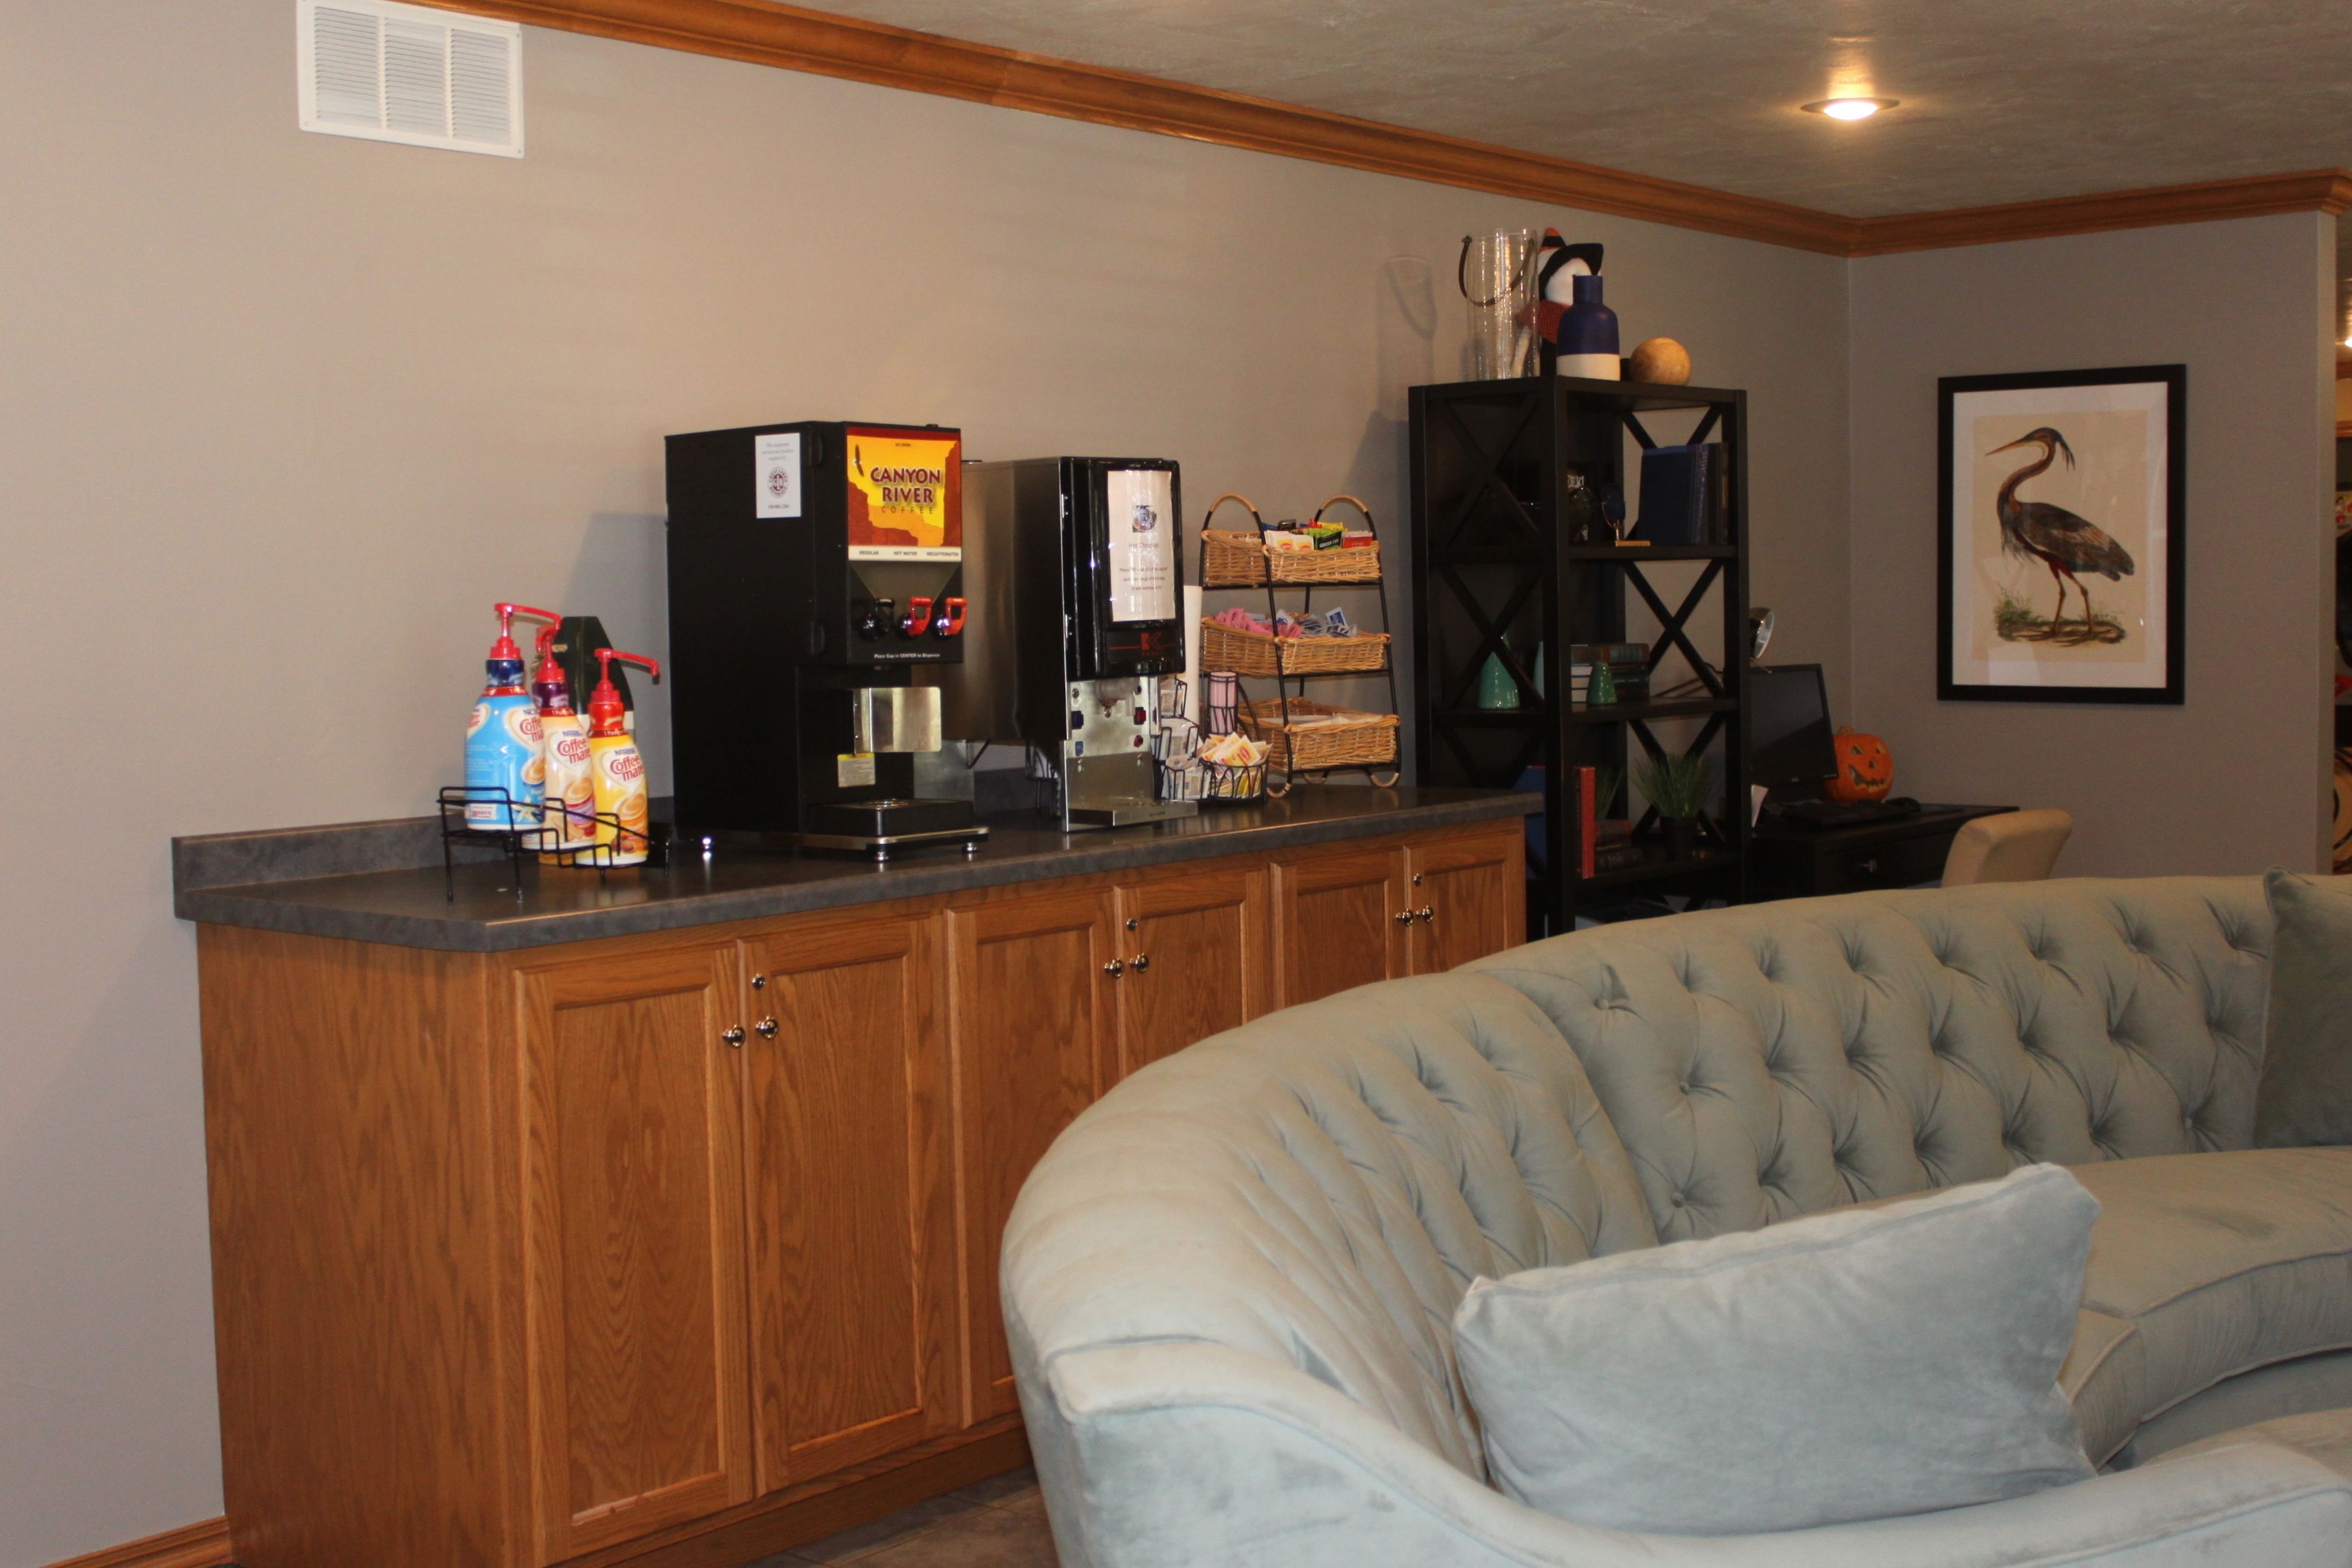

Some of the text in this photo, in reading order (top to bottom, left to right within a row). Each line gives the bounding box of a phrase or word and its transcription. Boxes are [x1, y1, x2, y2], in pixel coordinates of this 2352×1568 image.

[870, 466, 941, 484] CANYON
[882, 487, 934, 503] RIVER
[881, 506, 933, 514] COFFEE
[623, 764, 644, 781] mate
